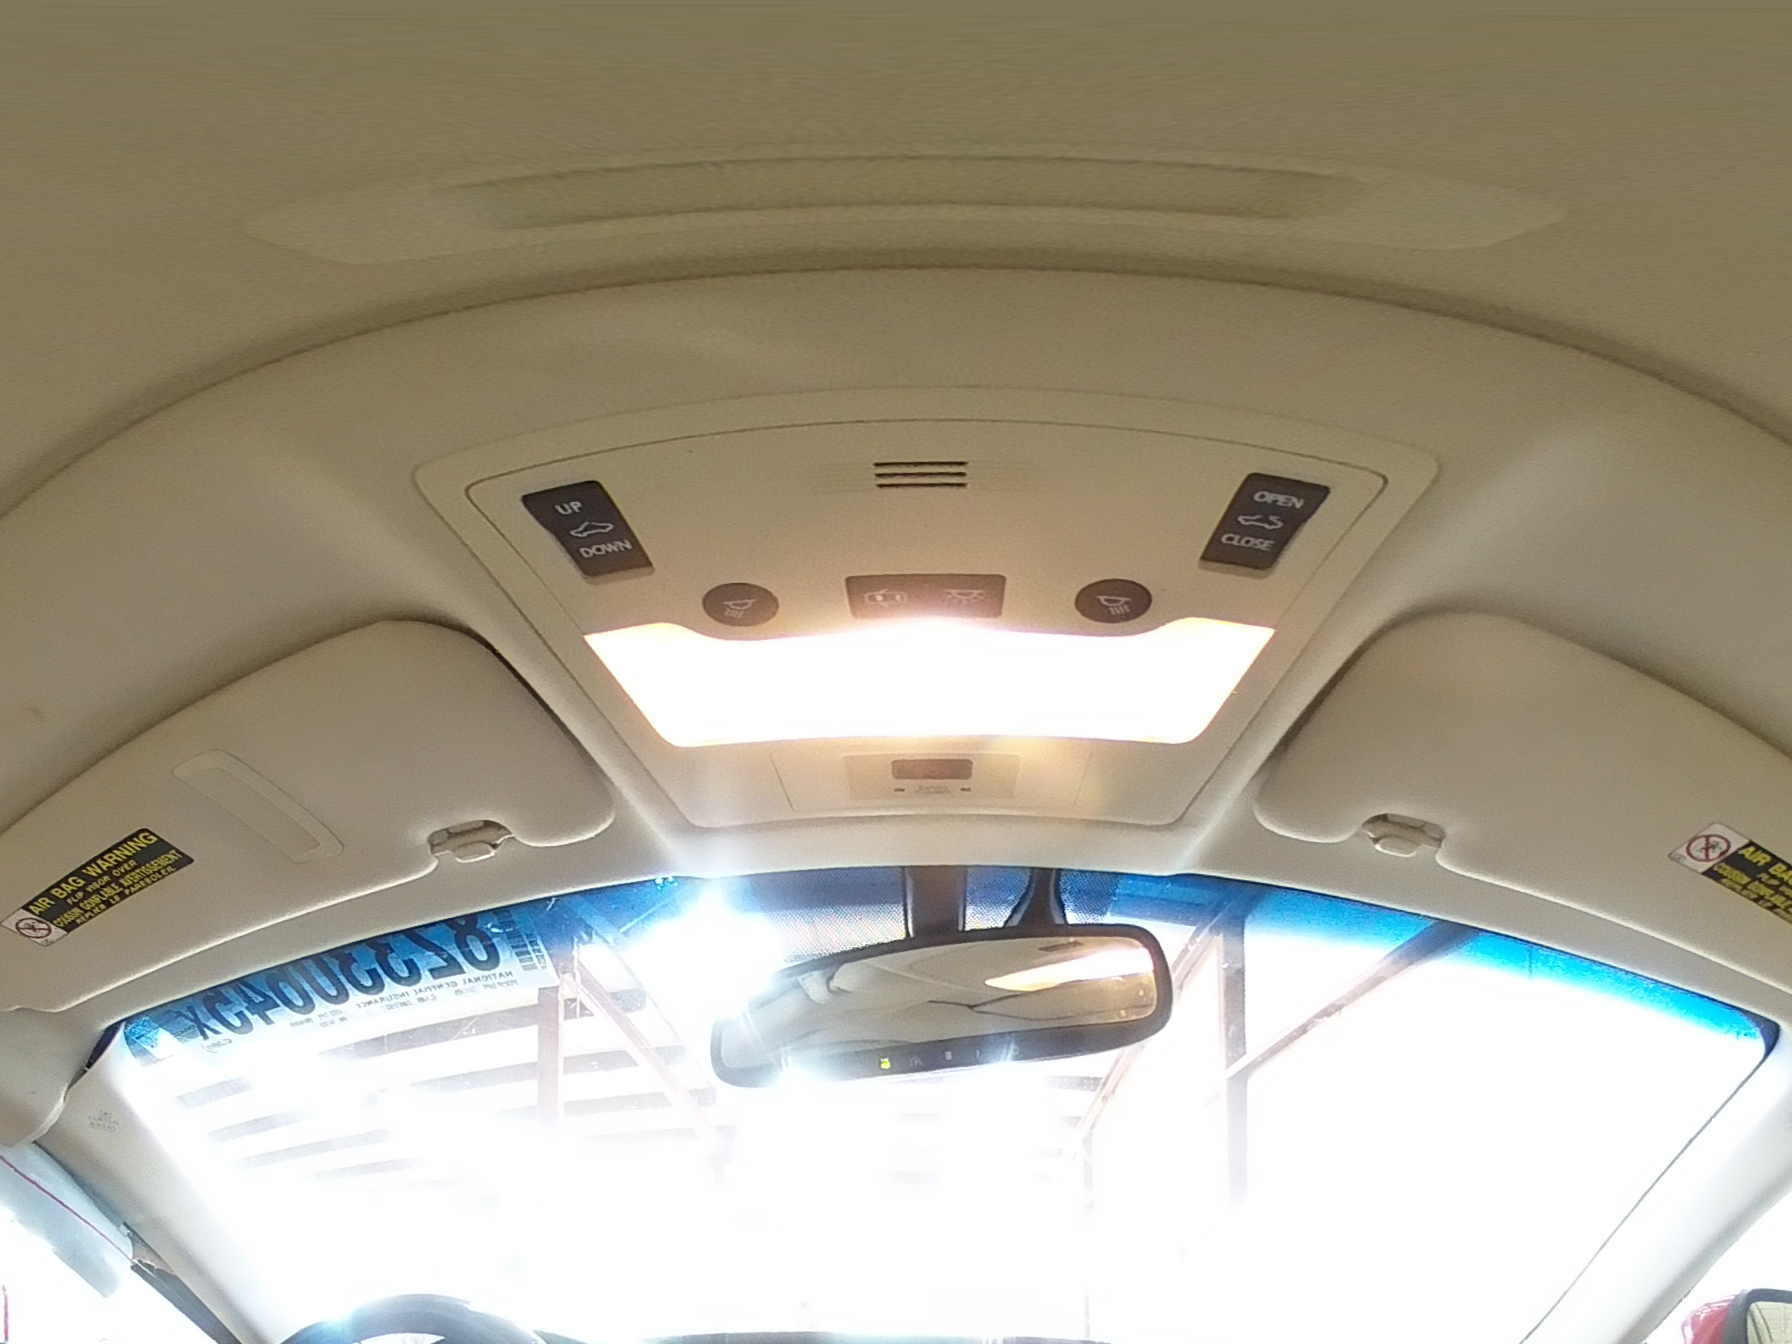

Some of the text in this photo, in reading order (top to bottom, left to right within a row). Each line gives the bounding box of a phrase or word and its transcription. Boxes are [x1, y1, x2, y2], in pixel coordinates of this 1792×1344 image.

[554, 501, 583, 515] UP
[1253, 491, 1304, 509] OPEN
[579, 540, 633, 558] DOWN
[1220, 533, 1276, 551] CLOSE
[1738, 845, 1772, 867] AIR
[29, 832, 158, 916] AIR BAG WARNING
[66, 859, 138, 905] FLIP VISOR OVER
